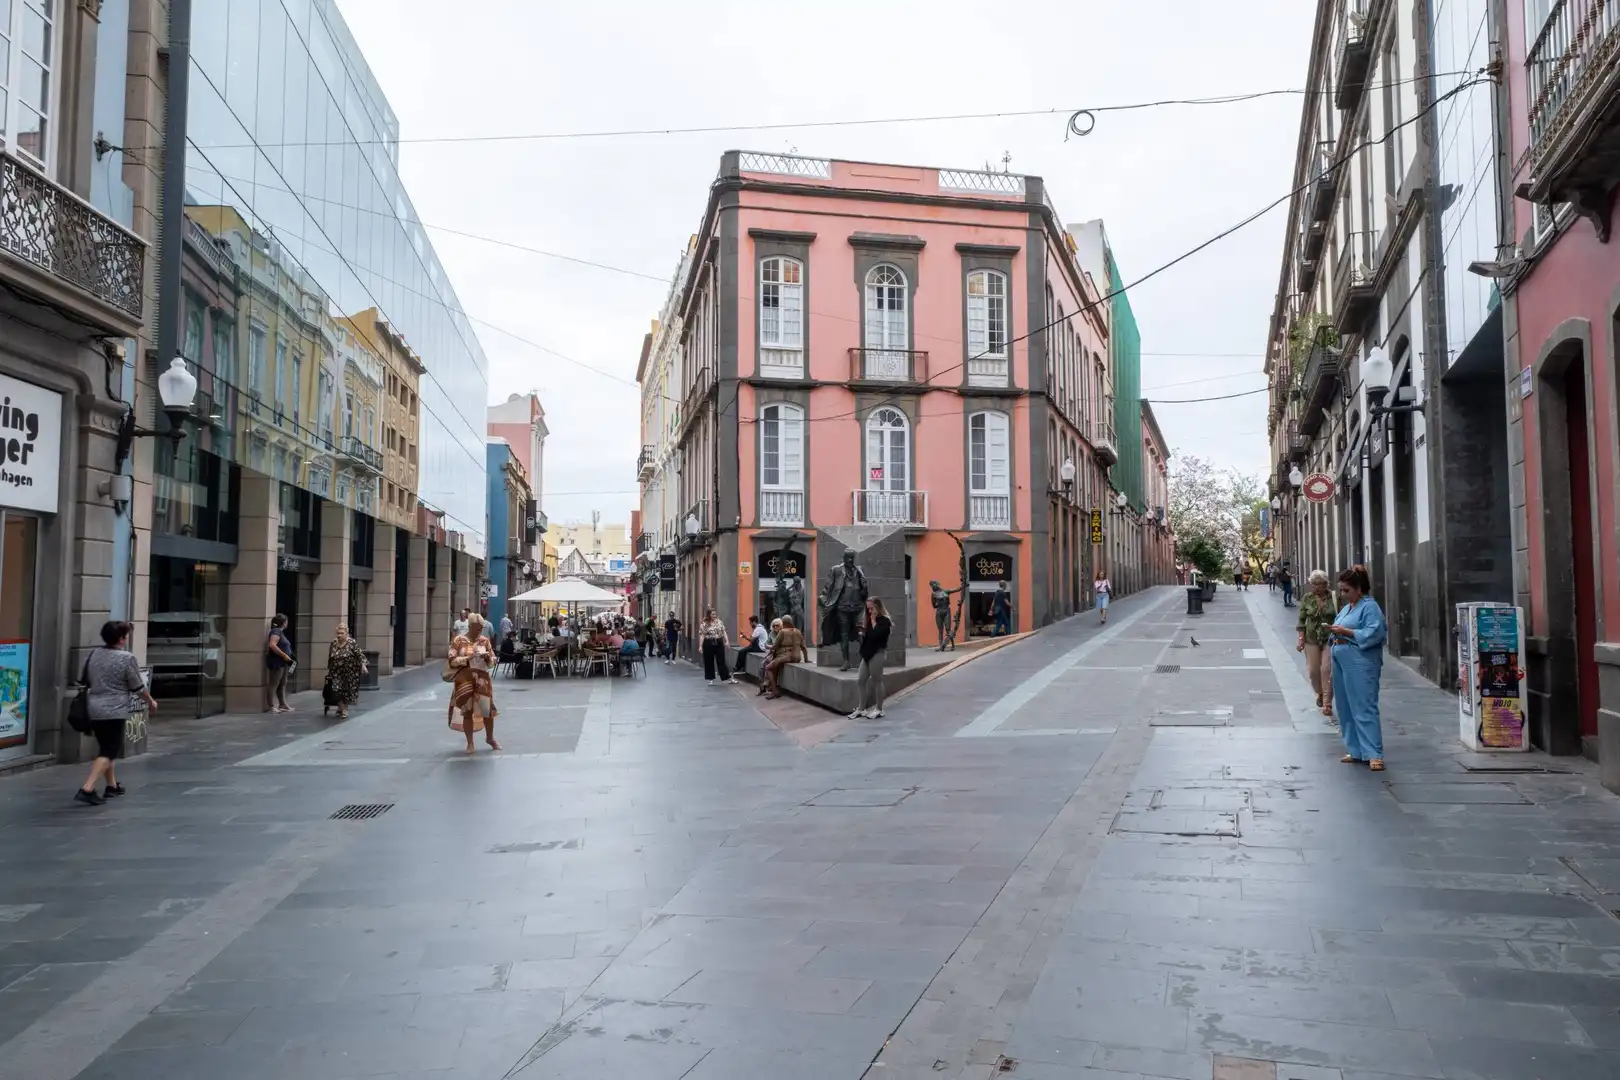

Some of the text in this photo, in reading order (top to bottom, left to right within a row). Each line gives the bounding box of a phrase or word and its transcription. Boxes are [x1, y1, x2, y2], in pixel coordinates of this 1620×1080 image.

[0, 396, 39, 441] ing
[0, 468, 33, 487] hagen
[1493, 699, 1512, 708] MOJO
